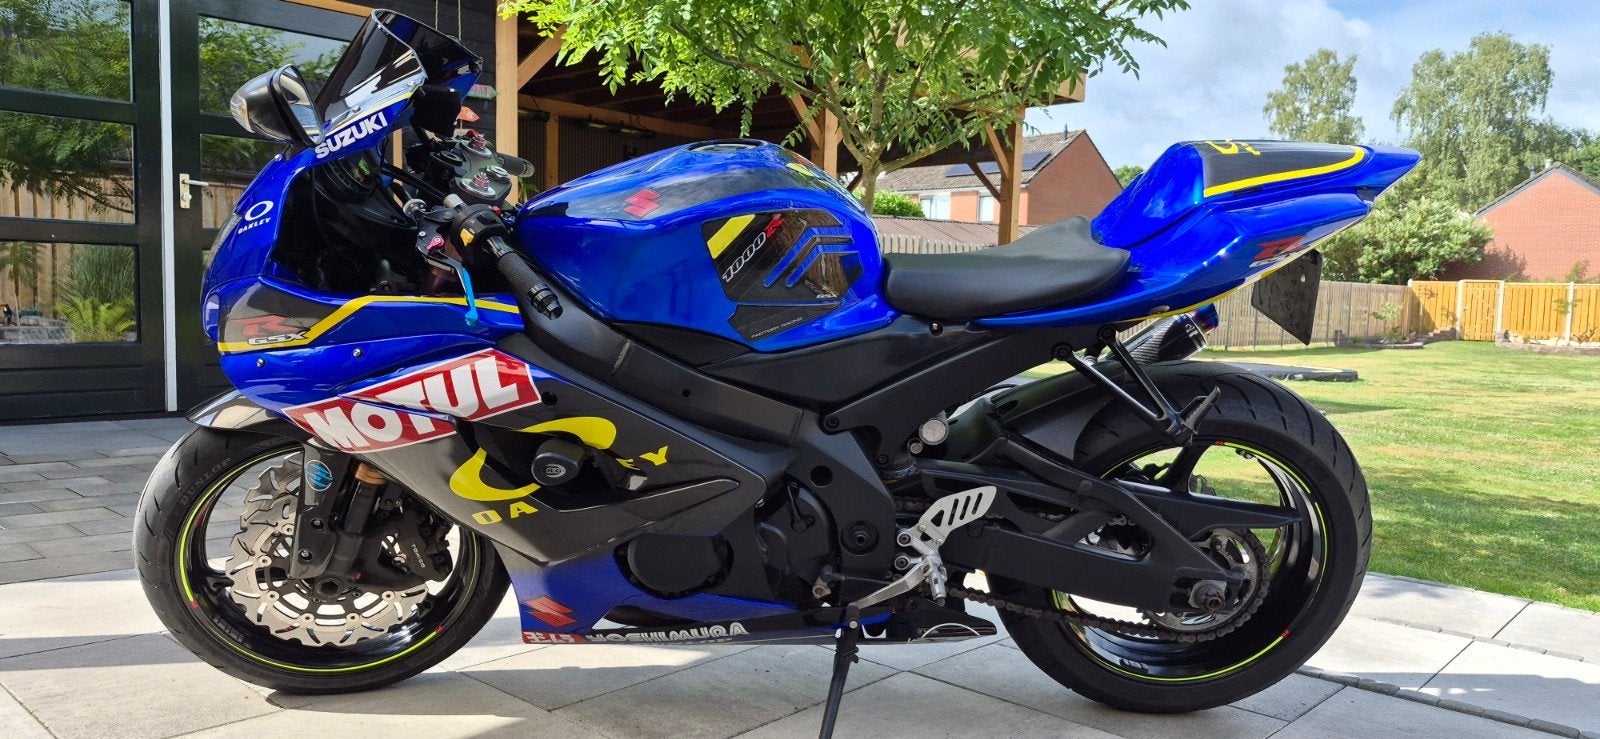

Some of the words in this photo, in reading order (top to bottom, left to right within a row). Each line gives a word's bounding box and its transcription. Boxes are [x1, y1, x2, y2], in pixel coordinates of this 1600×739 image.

[314, 111, 389, 159] SUZUKI
[237, 216, 272, 235] OAKLEY
[303, 355, 520, 449] MOTUL
[585, 621, 750, 642] YOSHIMURA
